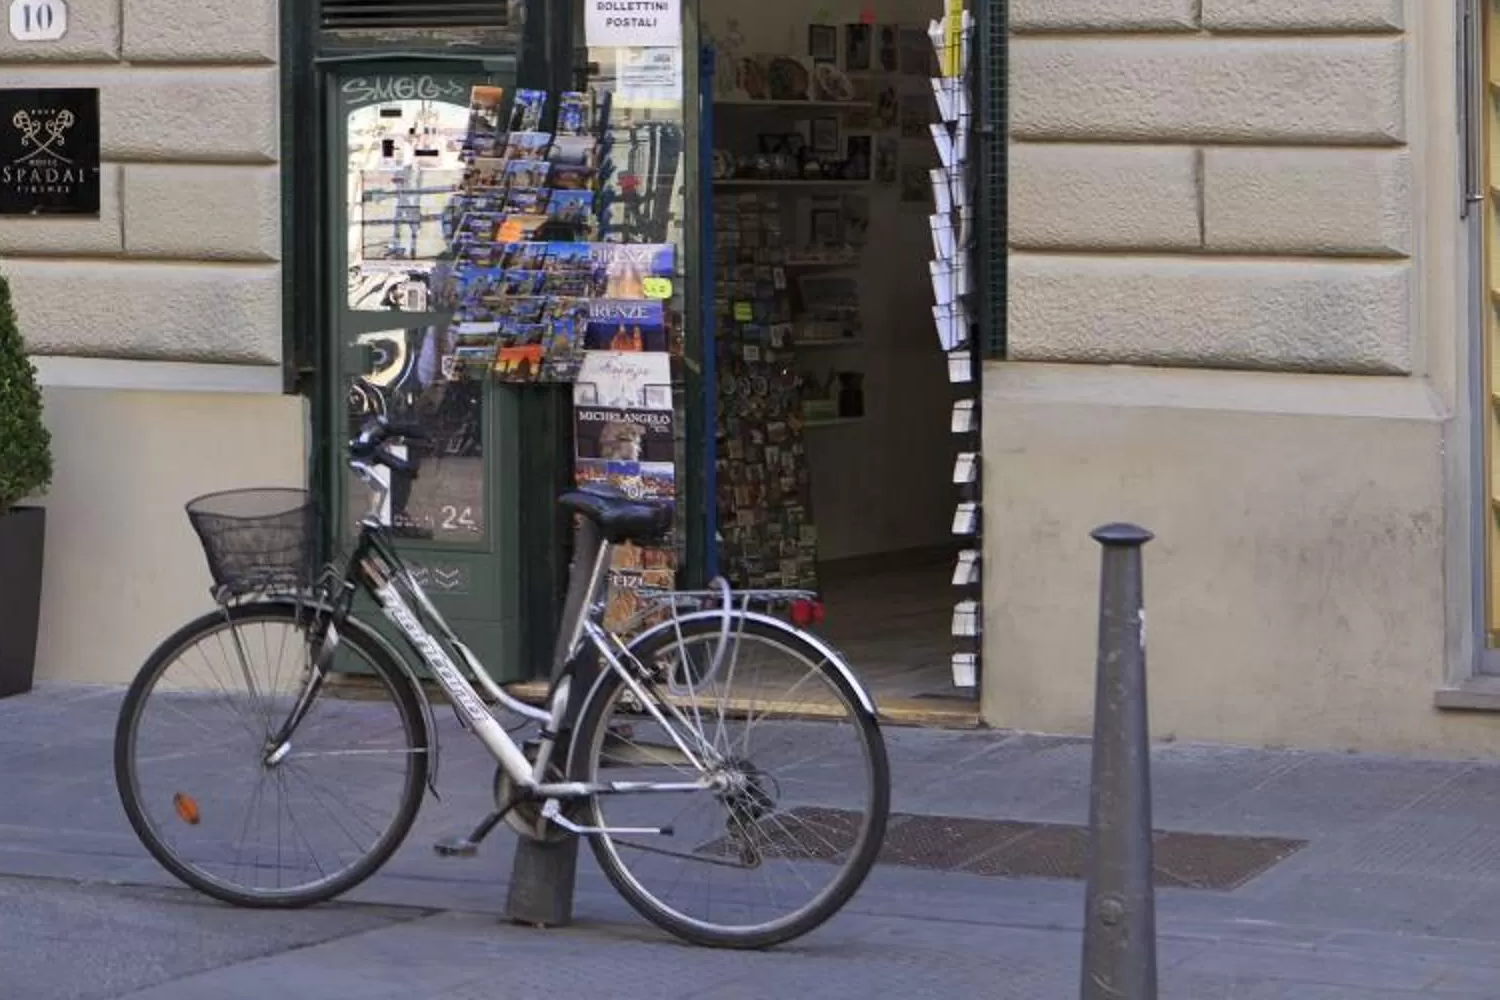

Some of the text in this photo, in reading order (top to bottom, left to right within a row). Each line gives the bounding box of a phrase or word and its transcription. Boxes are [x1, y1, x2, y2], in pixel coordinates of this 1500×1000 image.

[23, 3, 53, 33] 10
[605, 17, 658, 27] POSTALI
[3, 165, 84, 183] SPADAI
[580, 410, 672, 425] MICHELANGELO
